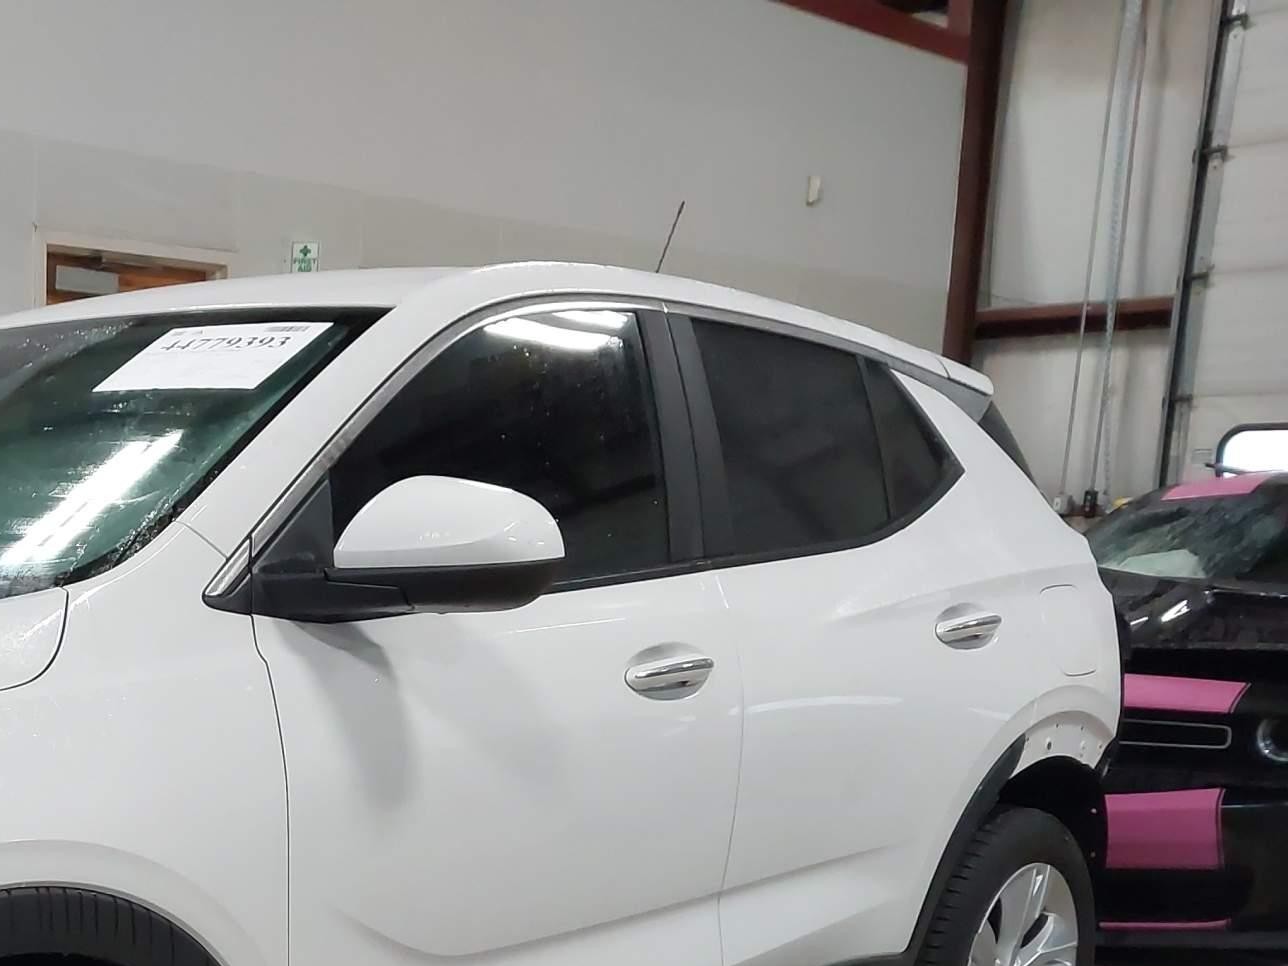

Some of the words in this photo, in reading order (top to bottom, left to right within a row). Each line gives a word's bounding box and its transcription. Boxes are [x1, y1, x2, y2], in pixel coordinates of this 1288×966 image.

[293, 257, 317, 265] FIRST
[297, 264, 312, 272] AID
[161, 336, 291, 351] 44779393
